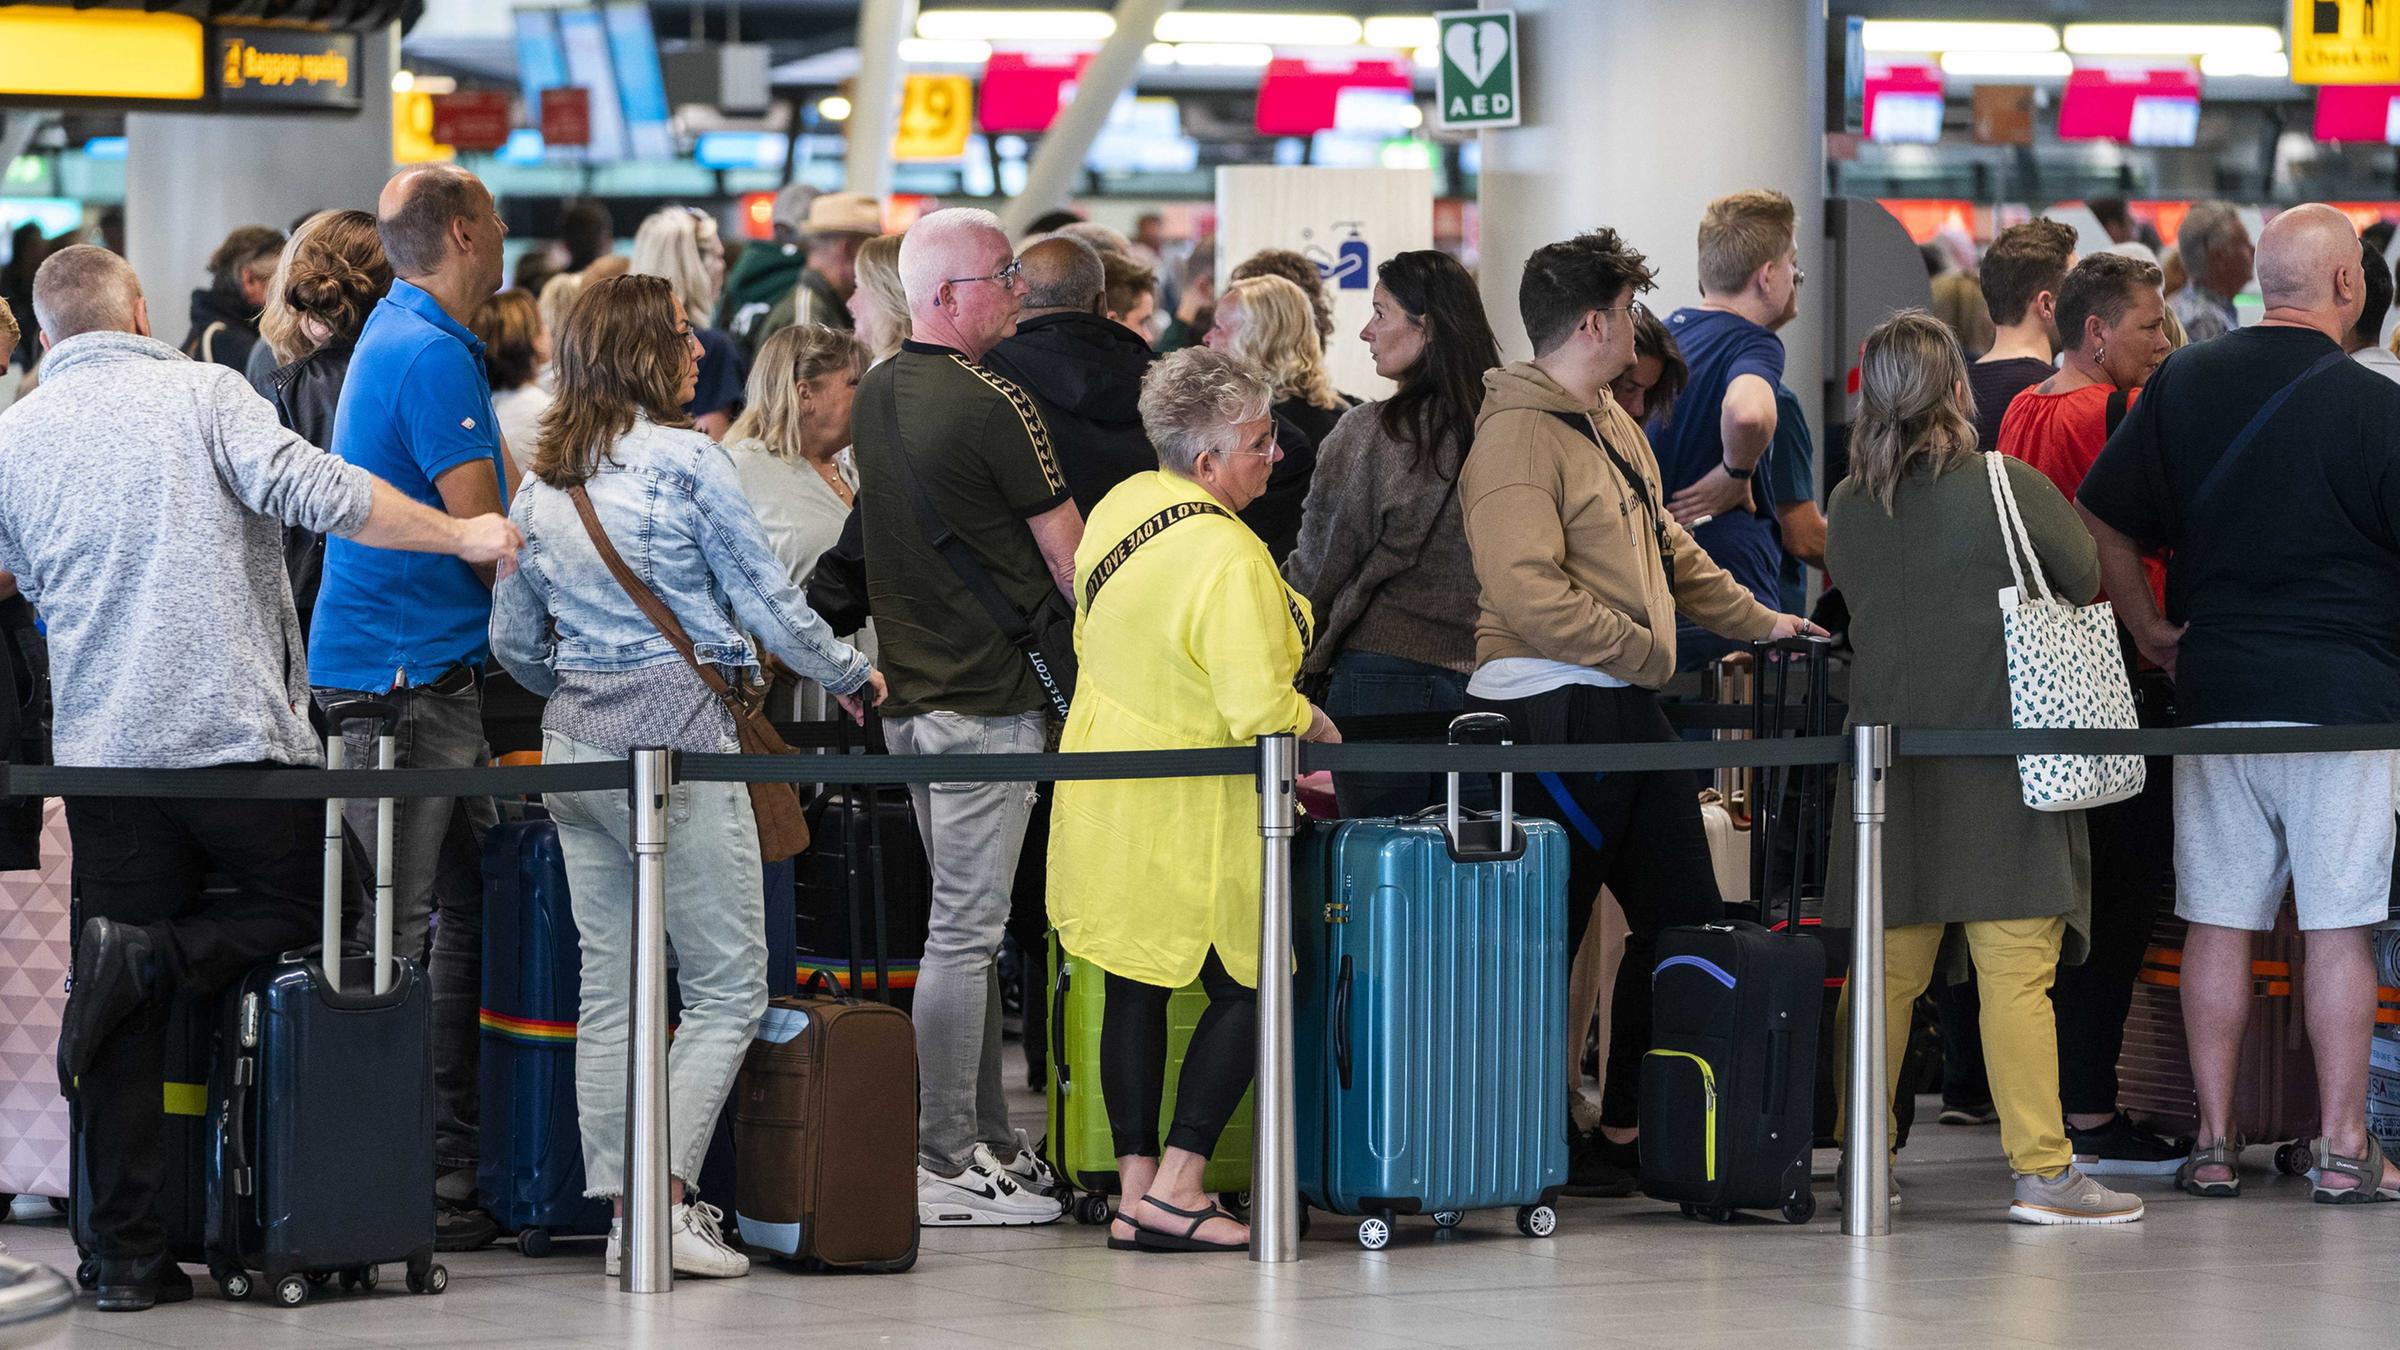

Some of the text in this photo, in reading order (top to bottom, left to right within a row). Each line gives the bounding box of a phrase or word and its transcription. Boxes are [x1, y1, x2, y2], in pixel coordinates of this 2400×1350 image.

[1449, 93, 1510, 117] AED
[1099, 543, 1127, 583] LOVE
[1127, 514, 1165, 553] LOVE
[1166, 504, 1216, 525] LOVE
[1028, 652, 1055, 687] SCOTT
[1052, 694, 1069, 720] YLE
